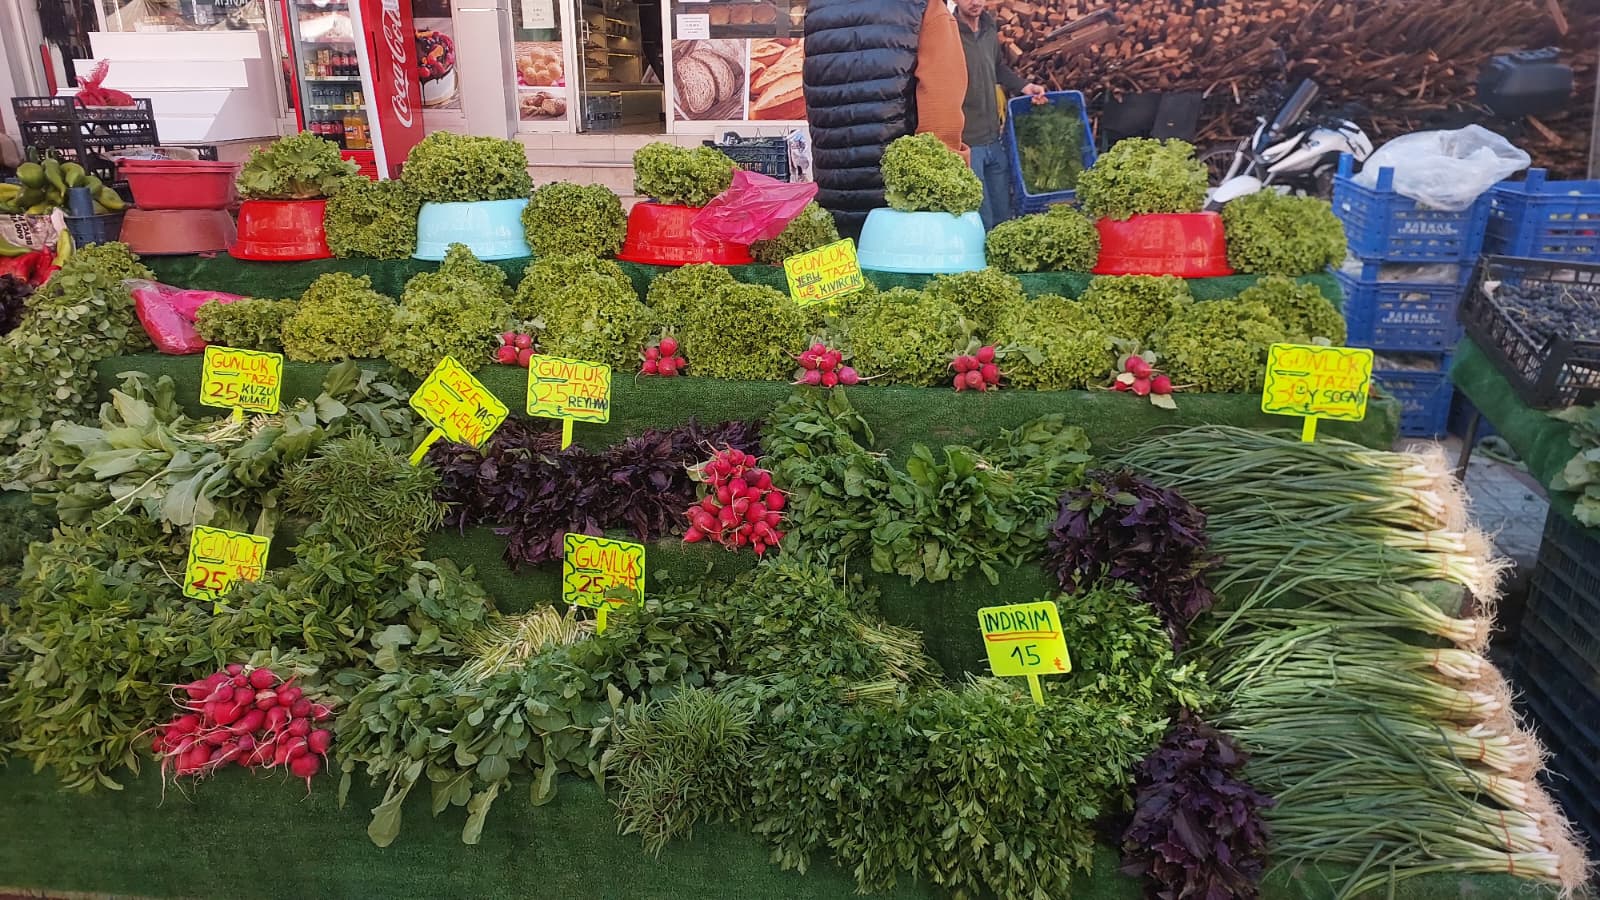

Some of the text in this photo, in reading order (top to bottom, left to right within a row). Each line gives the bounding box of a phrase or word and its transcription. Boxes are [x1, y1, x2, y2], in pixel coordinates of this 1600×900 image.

[823, 261, 858, 280] TAZE
[242, 372, 277, 386] TAZE
[1313, 375, 1360, 390] TAZE
[209, 381, 275, 400] 25 KUZU
[537, 382, 607, 403] 25 TAZE
[423, 390, 450, 415] 25
[192, 566, 227, 591] 25
[578, 575, 605, 594] 25
[1010, 644, 1041, 666] 15
